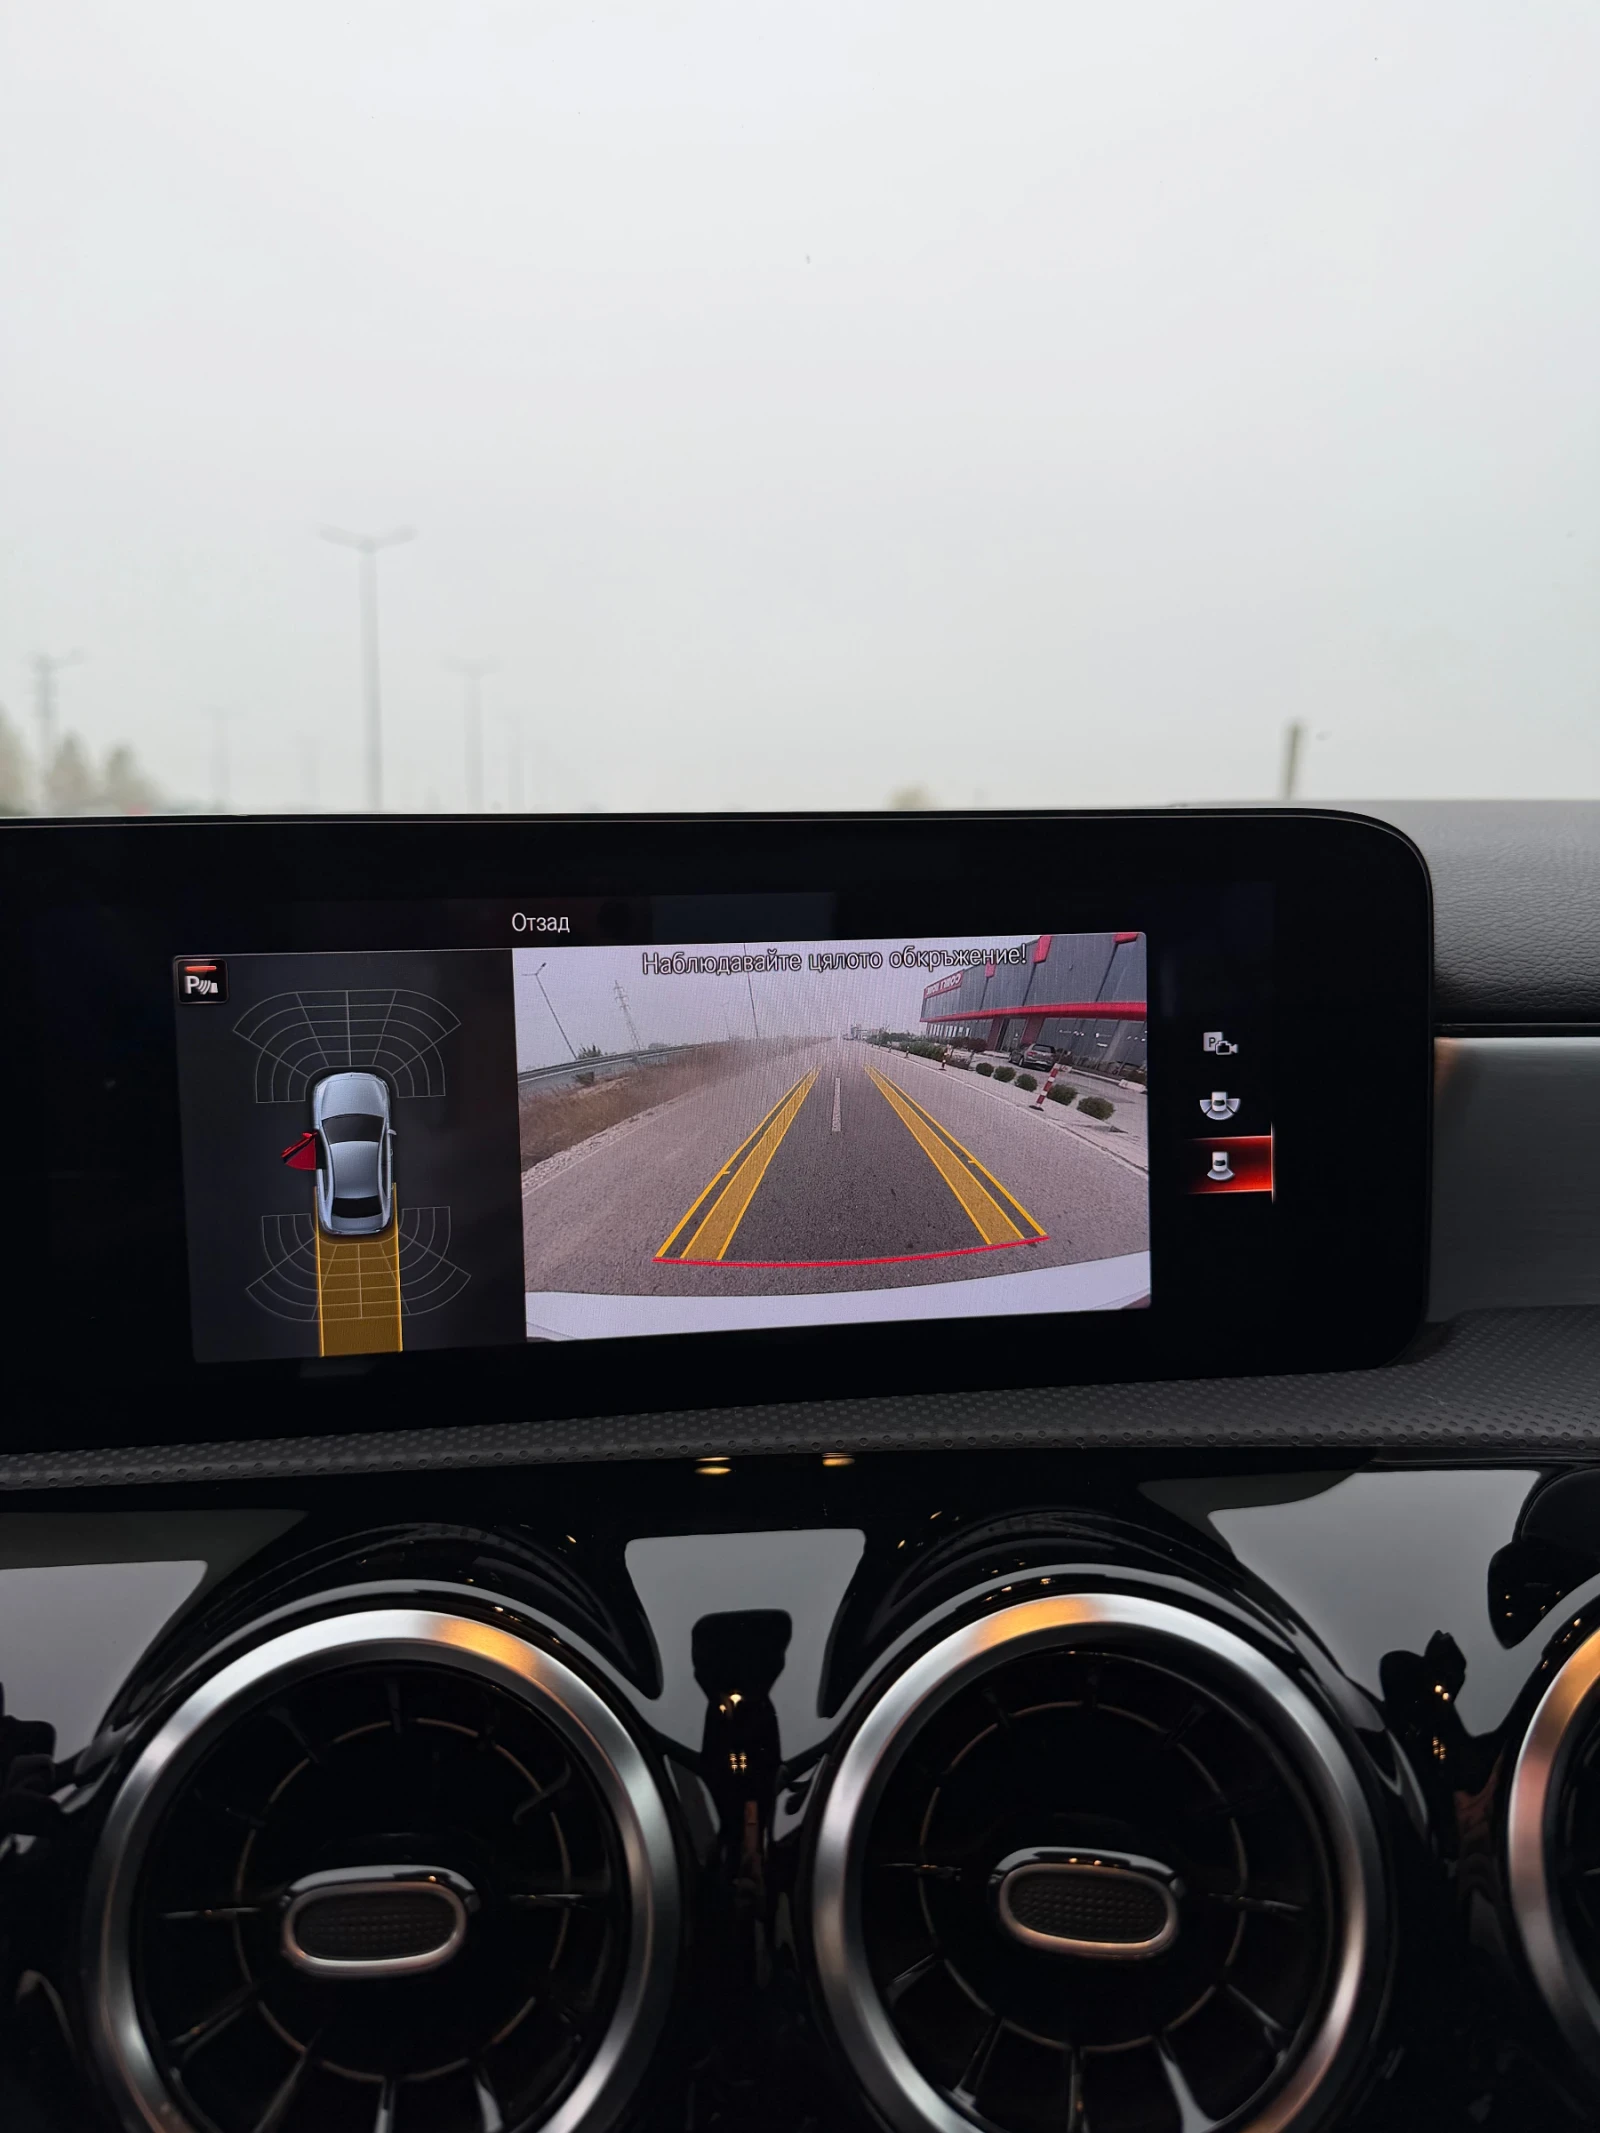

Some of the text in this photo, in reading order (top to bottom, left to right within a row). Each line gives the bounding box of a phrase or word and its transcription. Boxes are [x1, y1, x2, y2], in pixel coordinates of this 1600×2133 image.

[511, 912, 571, 933] Отзад
[642, 943, 1028, 976] Наблюдавайте цялото обкръжение!
